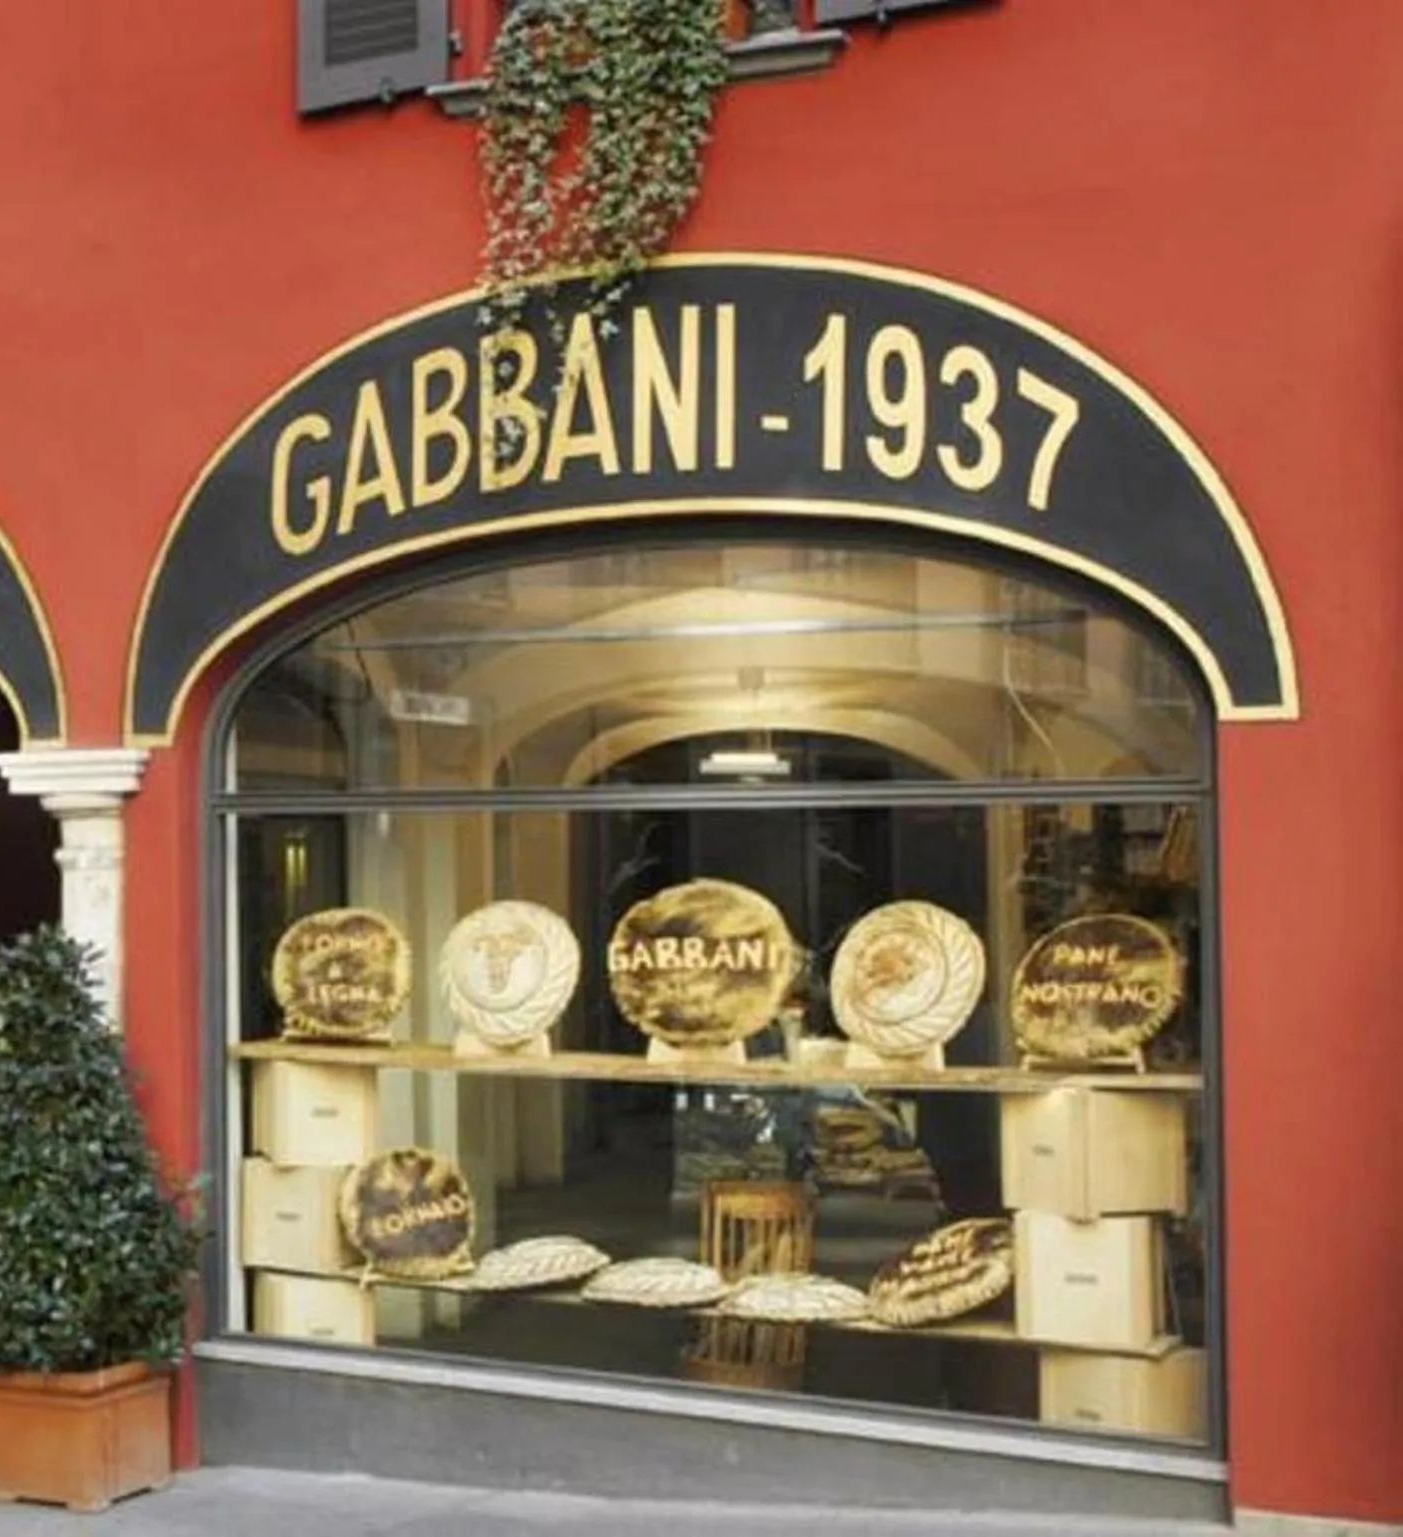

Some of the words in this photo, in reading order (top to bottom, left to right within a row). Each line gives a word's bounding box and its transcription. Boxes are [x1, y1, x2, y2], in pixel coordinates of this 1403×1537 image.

[271, 303, 736, 556] GABBANI
[803, 313, 1079, 512] 1937
[608, 936, 781, 972] GABBANI
